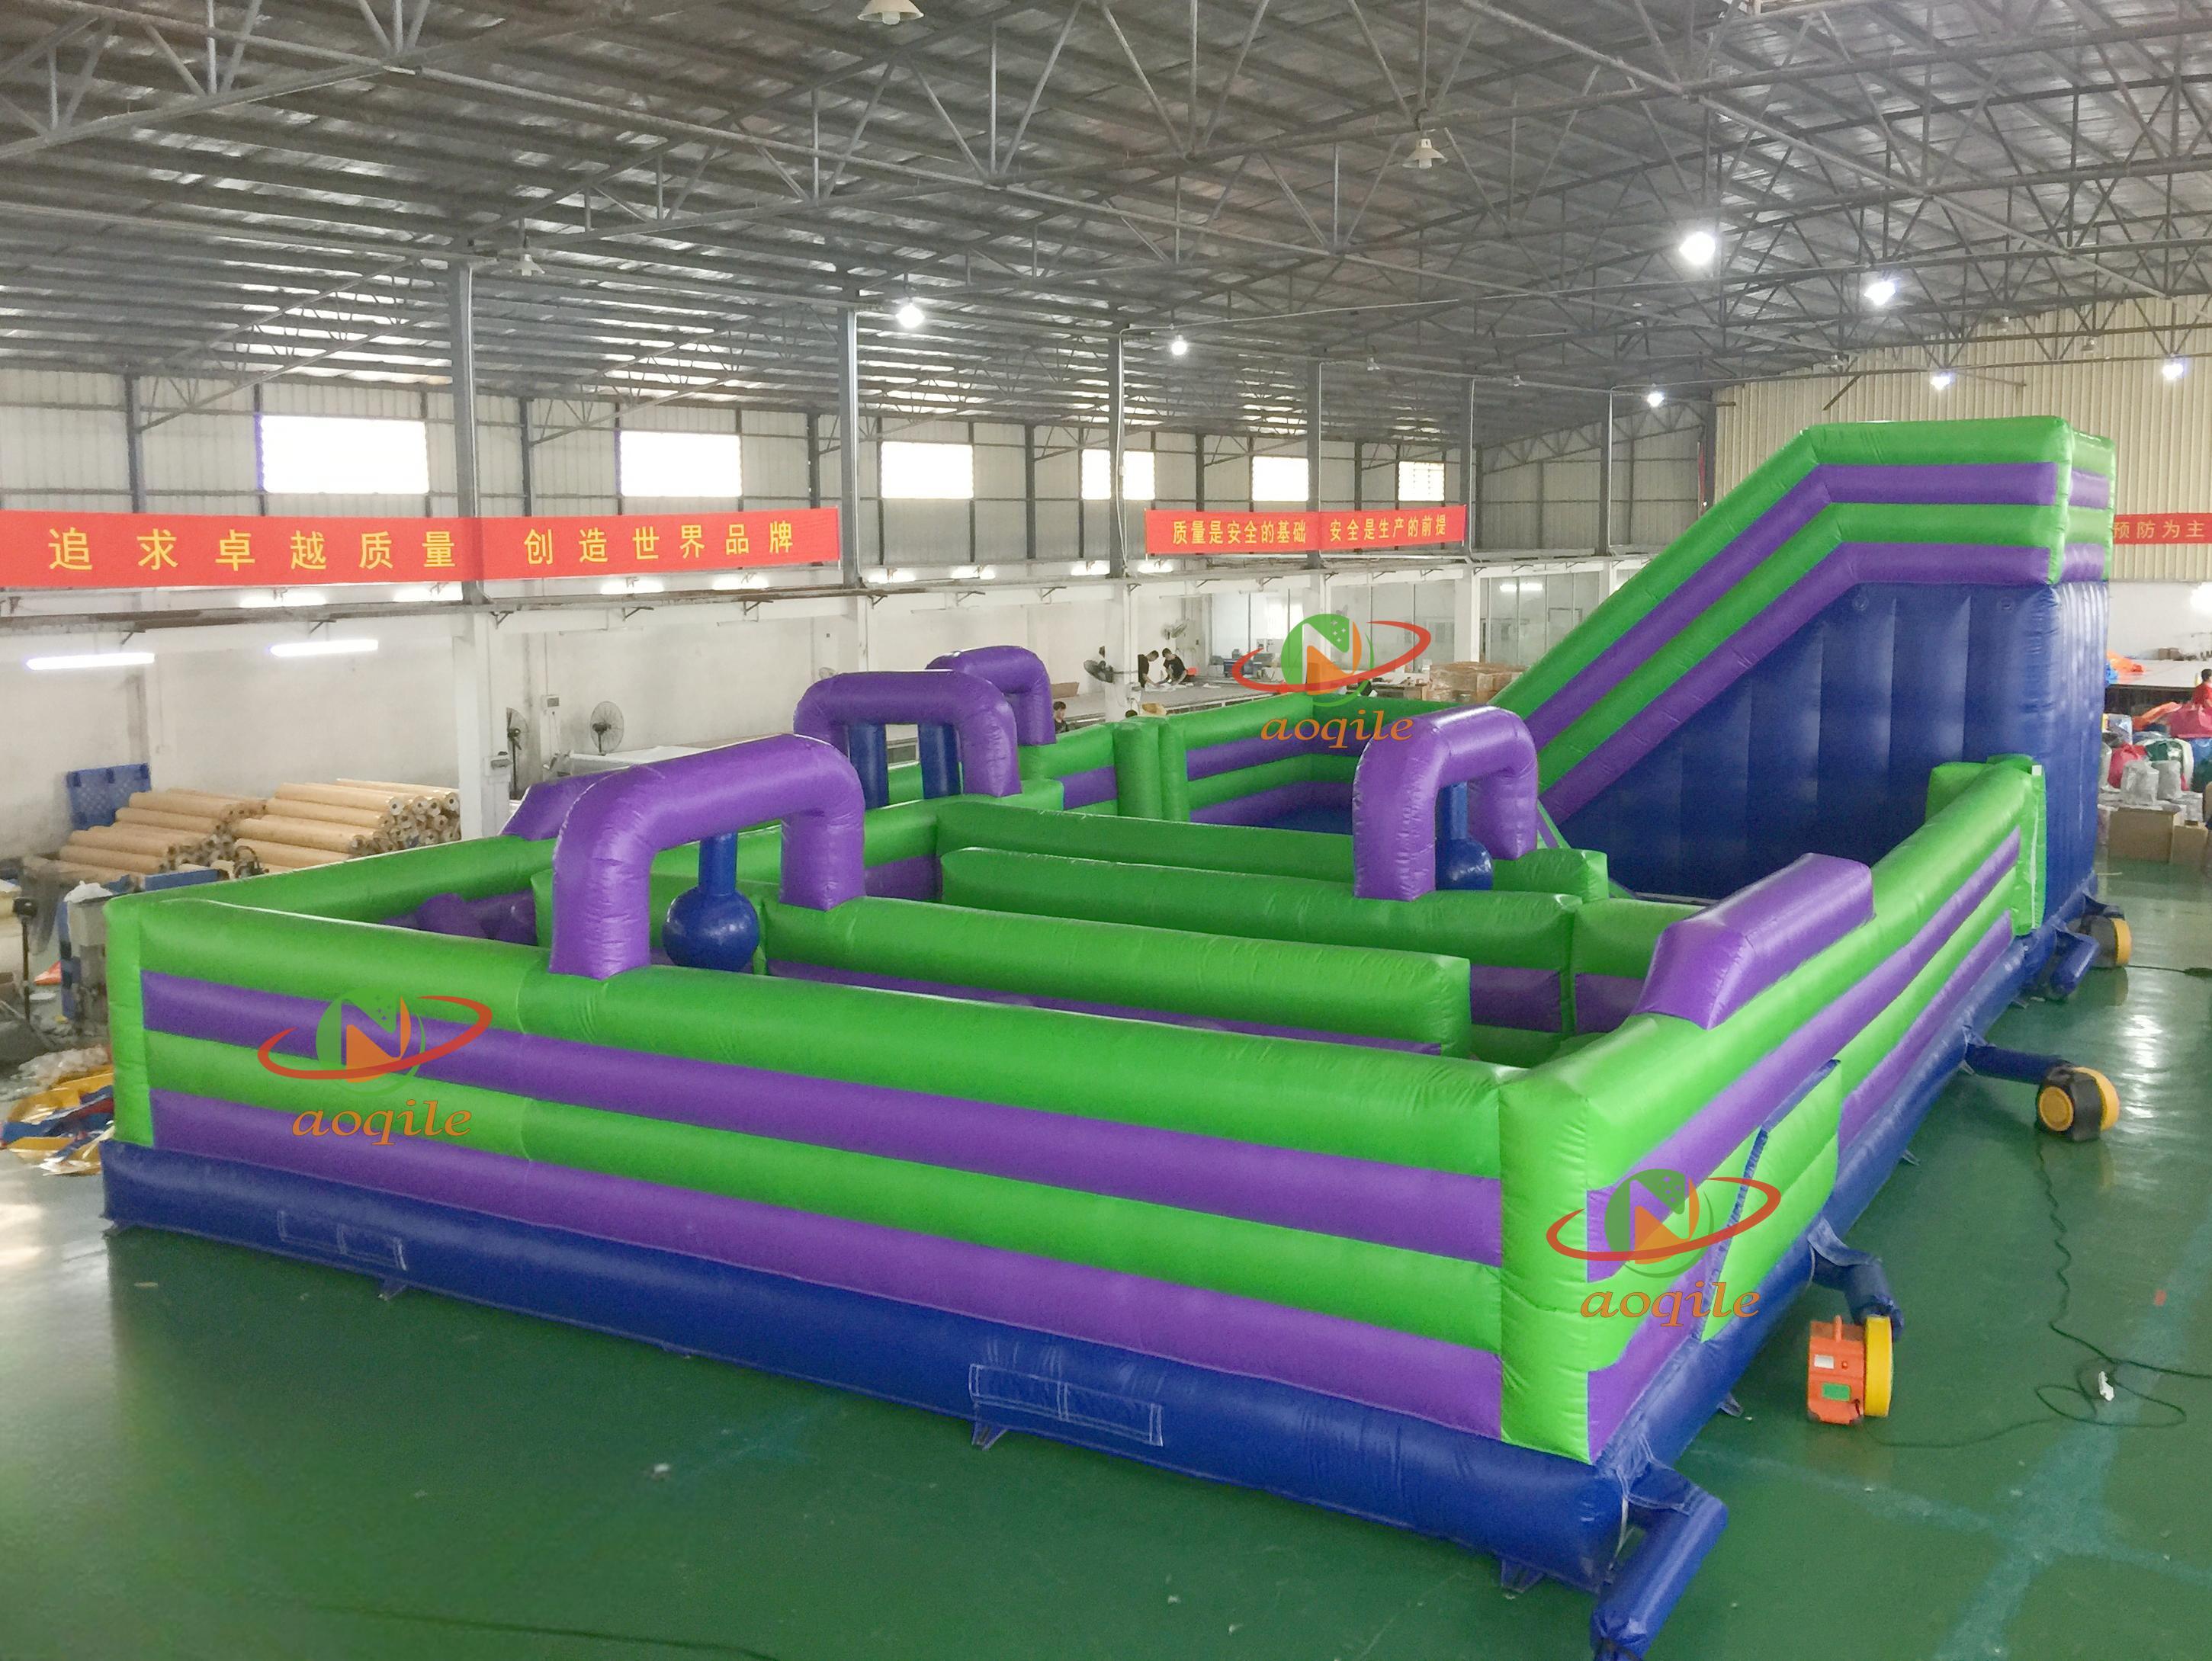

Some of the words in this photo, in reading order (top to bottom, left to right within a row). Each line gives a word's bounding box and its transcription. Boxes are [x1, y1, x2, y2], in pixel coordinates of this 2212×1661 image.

[1173, 520, 1307, 545] 质量是安全的基础
[1329, 514, 1447, 541] 安全是生产的前提
[2113, 519, 2205, 540] 预防为主
[48, 527, 457, 571] 追求卓越质量
[524, 520, 794, 566] 创造世界品牌
